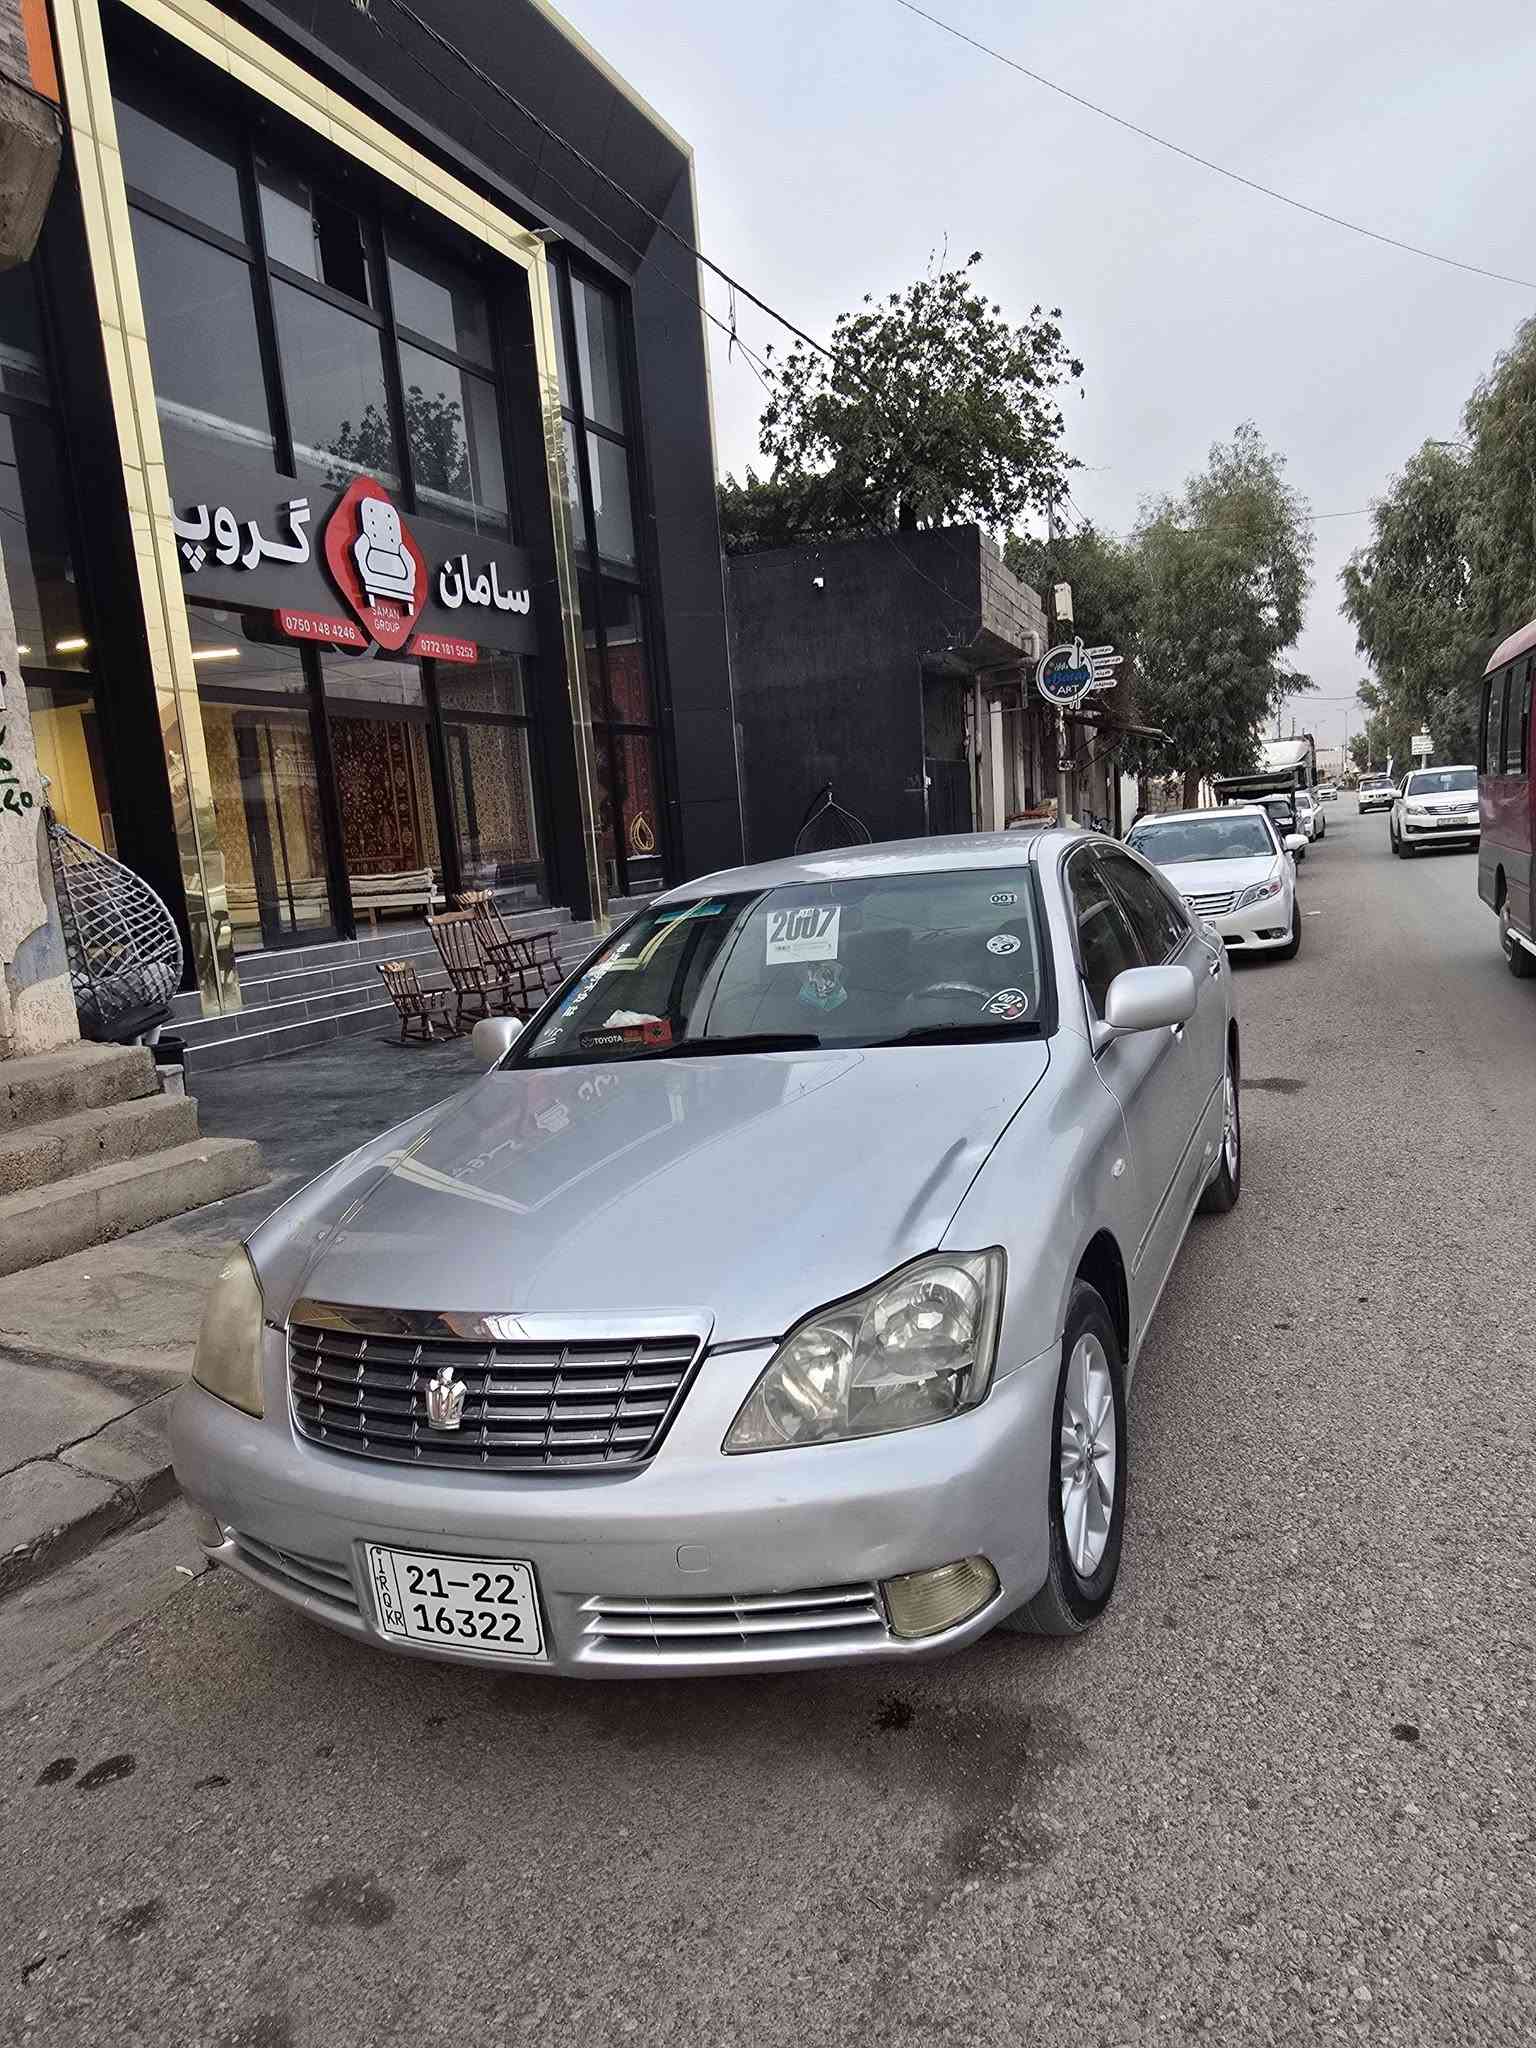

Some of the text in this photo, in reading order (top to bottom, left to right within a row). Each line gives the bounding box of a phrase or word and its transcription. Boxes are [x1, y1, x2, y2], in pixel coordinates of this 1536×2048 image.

[170, 497, 530, 615] سامان گروپ
[371, 605, 400, 620] SAMAN
[286, 616, 356, 640] 0750 148 4246
[374, 619, 400, 633] GROUP
[421, 639, 440, 653] 0772
[1056, 684, 1079, 696] ART
[769, 908, 837, 943] 2007
[593, 1034, 624, 1045] TOYOTA
[406, 1565, 519, 1605] 21-22
[385, 1609, 404, 1627] KR
[413, 1604, 524, 1643] 16322
